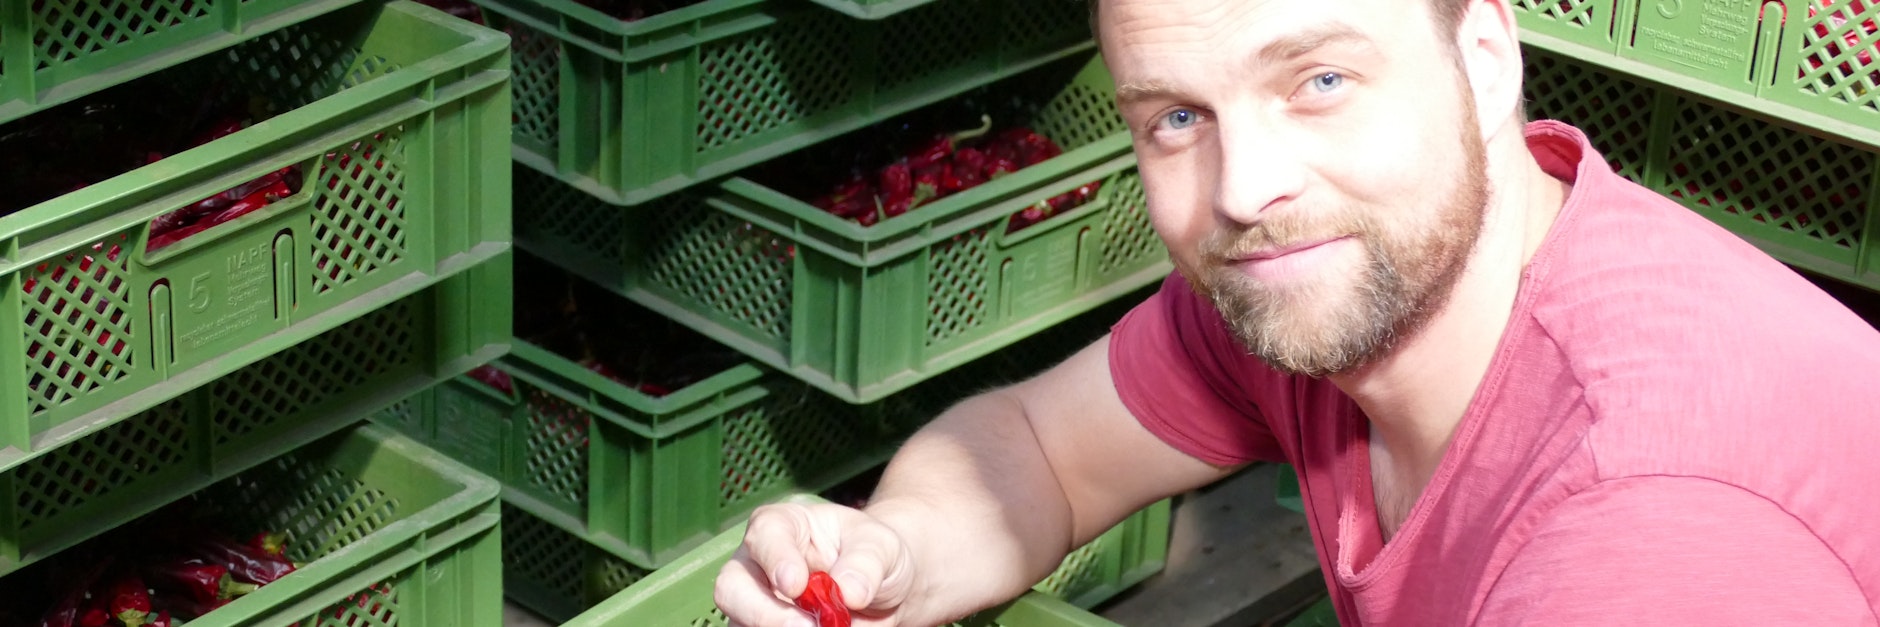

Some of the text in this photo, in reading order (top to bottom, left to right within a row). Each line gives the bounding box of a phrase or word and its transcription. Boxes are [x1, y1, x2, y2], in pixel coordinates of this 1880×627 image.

[1699, 25, 1736, 43] System
[227, 243, 268, 272] NAPF
[189, 271, 211, 313] 5
